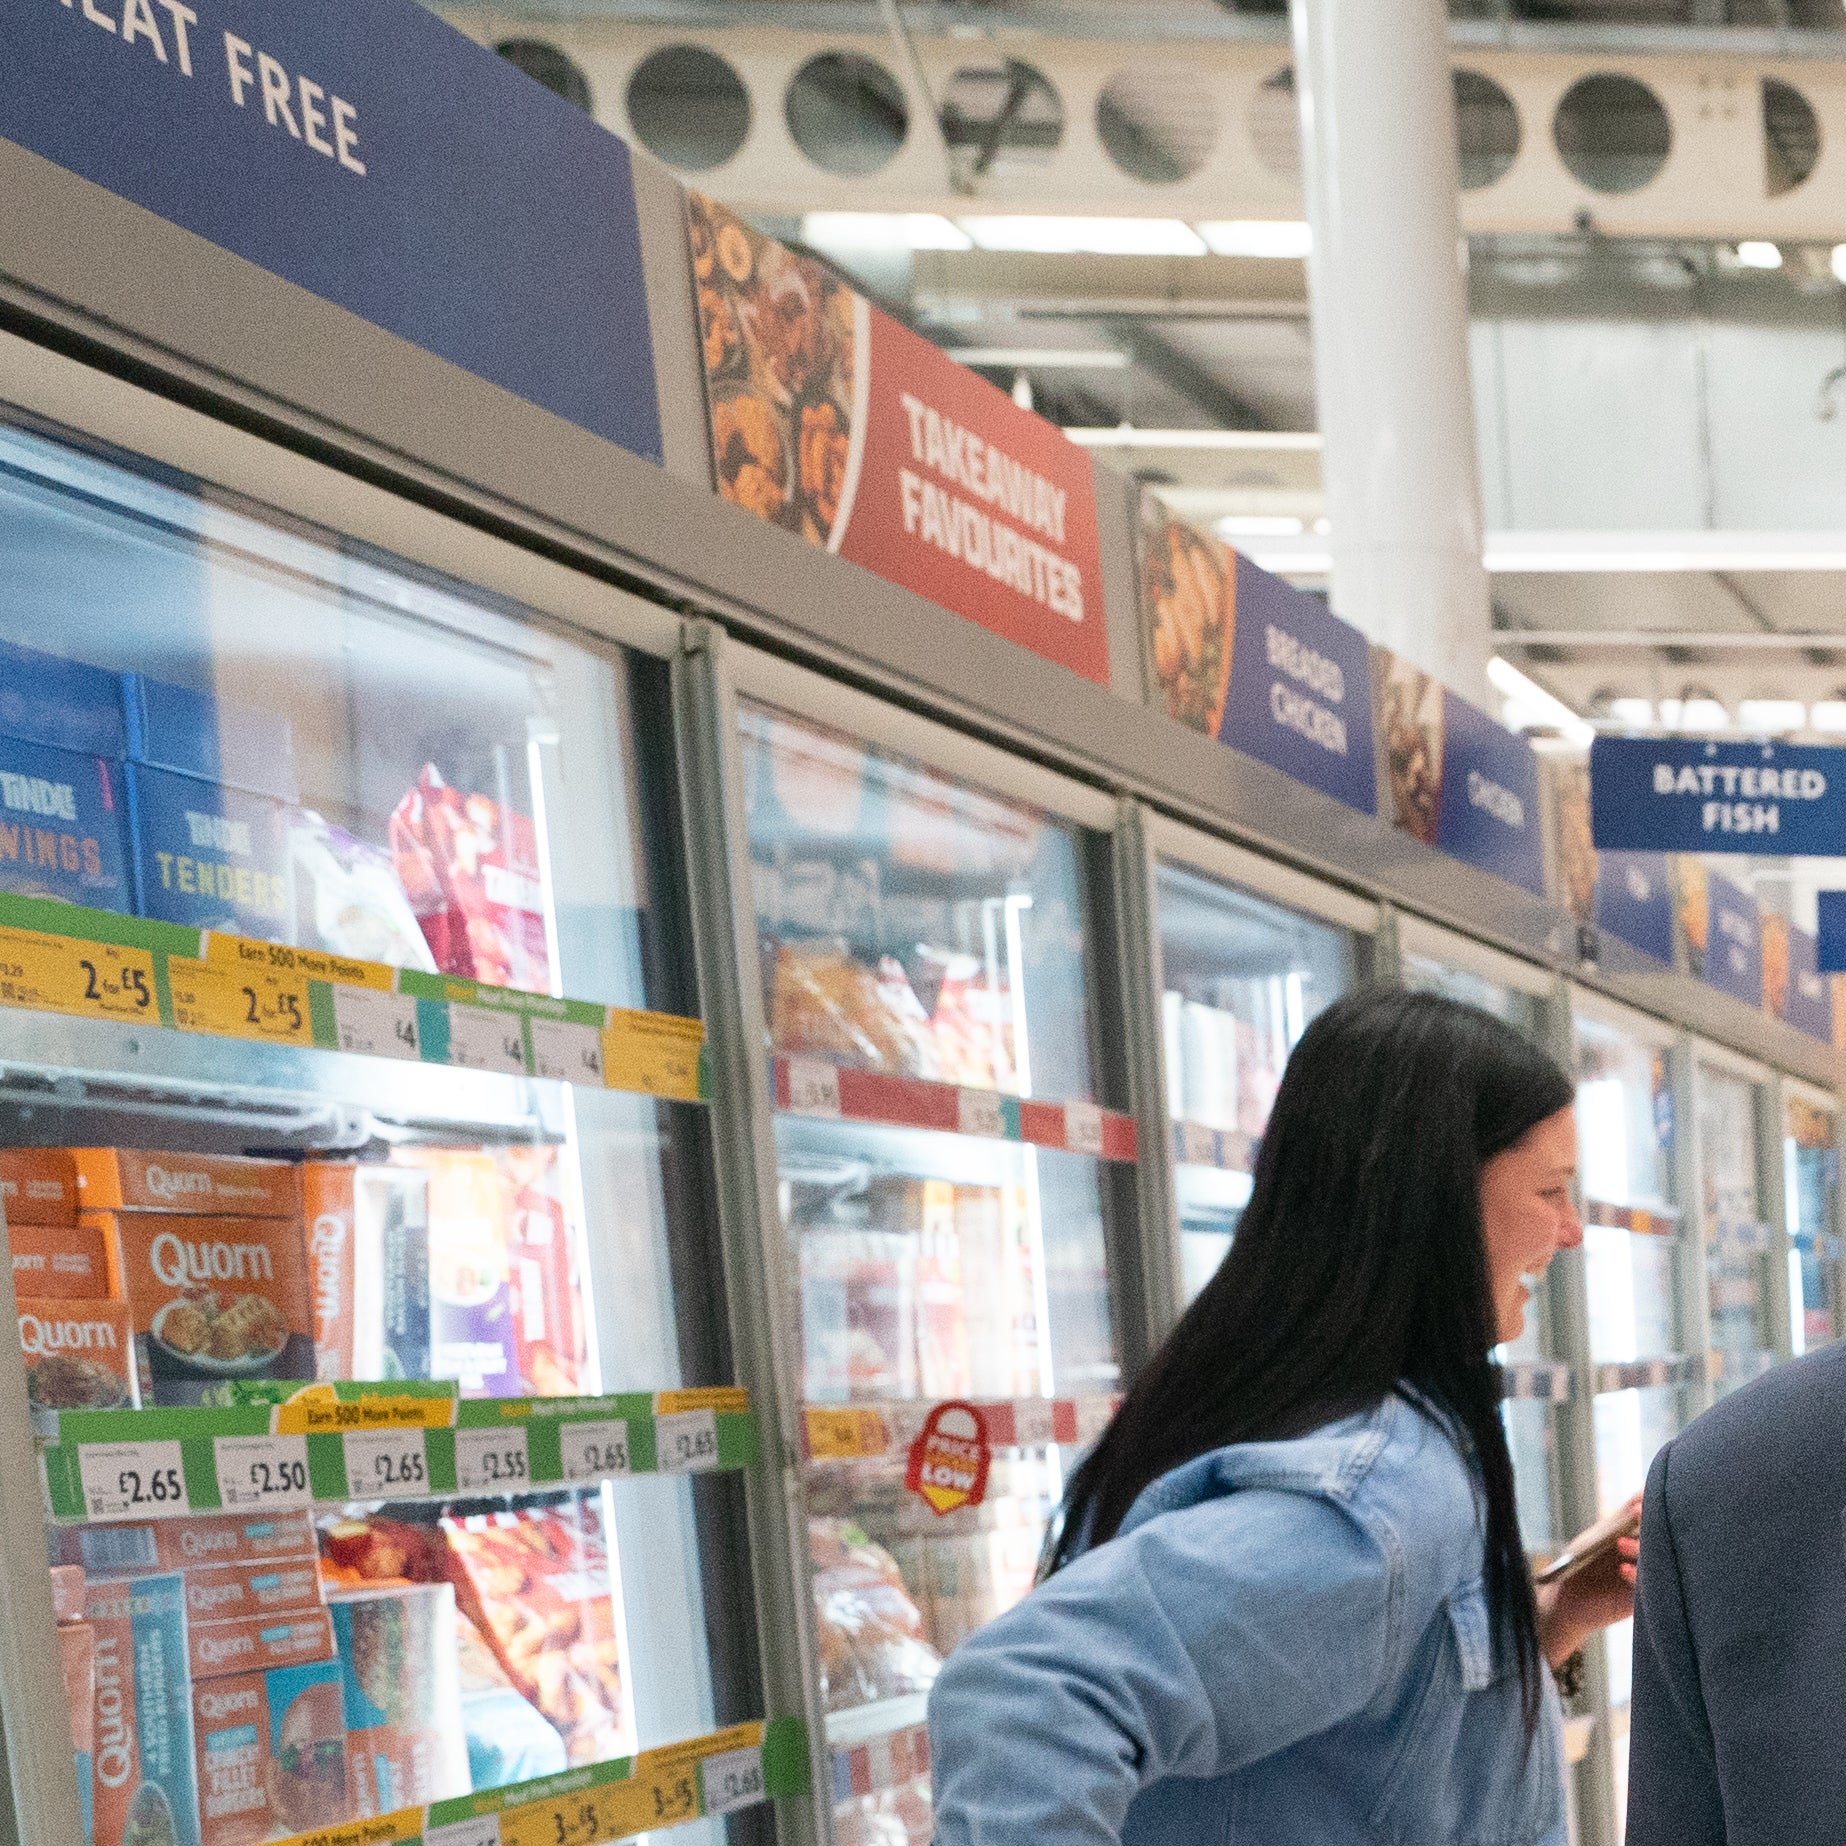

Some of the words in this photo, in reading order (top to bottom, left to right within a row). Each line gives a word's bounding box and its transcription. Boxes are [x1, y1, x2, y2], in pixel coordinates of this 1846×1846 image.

[223, 30, 367, 177] FREE
[900, 391, 1067, 547] TAKEAWAY
[898, 463, 1086, 625] FAVOURITES
[1268, 681, 1350, 757] CHICKEN
[1651, 763, 1826, 801] BATTERED
[1702, 801, 1780, 834] FISH
[156, 851, 288, 912] TENDERS
[267, 944, 296, 970] 500
[79, 959, 101, 1001] 2
[122, 966, 151, 1009] £5
[241, 987, 261, 1025] 2
[277, 992, 303, 1032] £5
[145, 1165, 213, 1201] Quorn
[148, 1231, 275, 1288] Quorn
[19, 1313, 117, 1358] Quorn
[333, 1405, 360, 1426] 500
[250, 1459, 307, 1497] £2.50
[375, 1453, 424, 1484] £2.65
[483, 1449, 527, 1481] £2.55
[919, 1459, 973, 1492] LOW
[118, 1467, 182, 1504] £2.65
[198, 1634, 255, 1665] Quorn
[94, 1637, 133, 1788] Quorn
